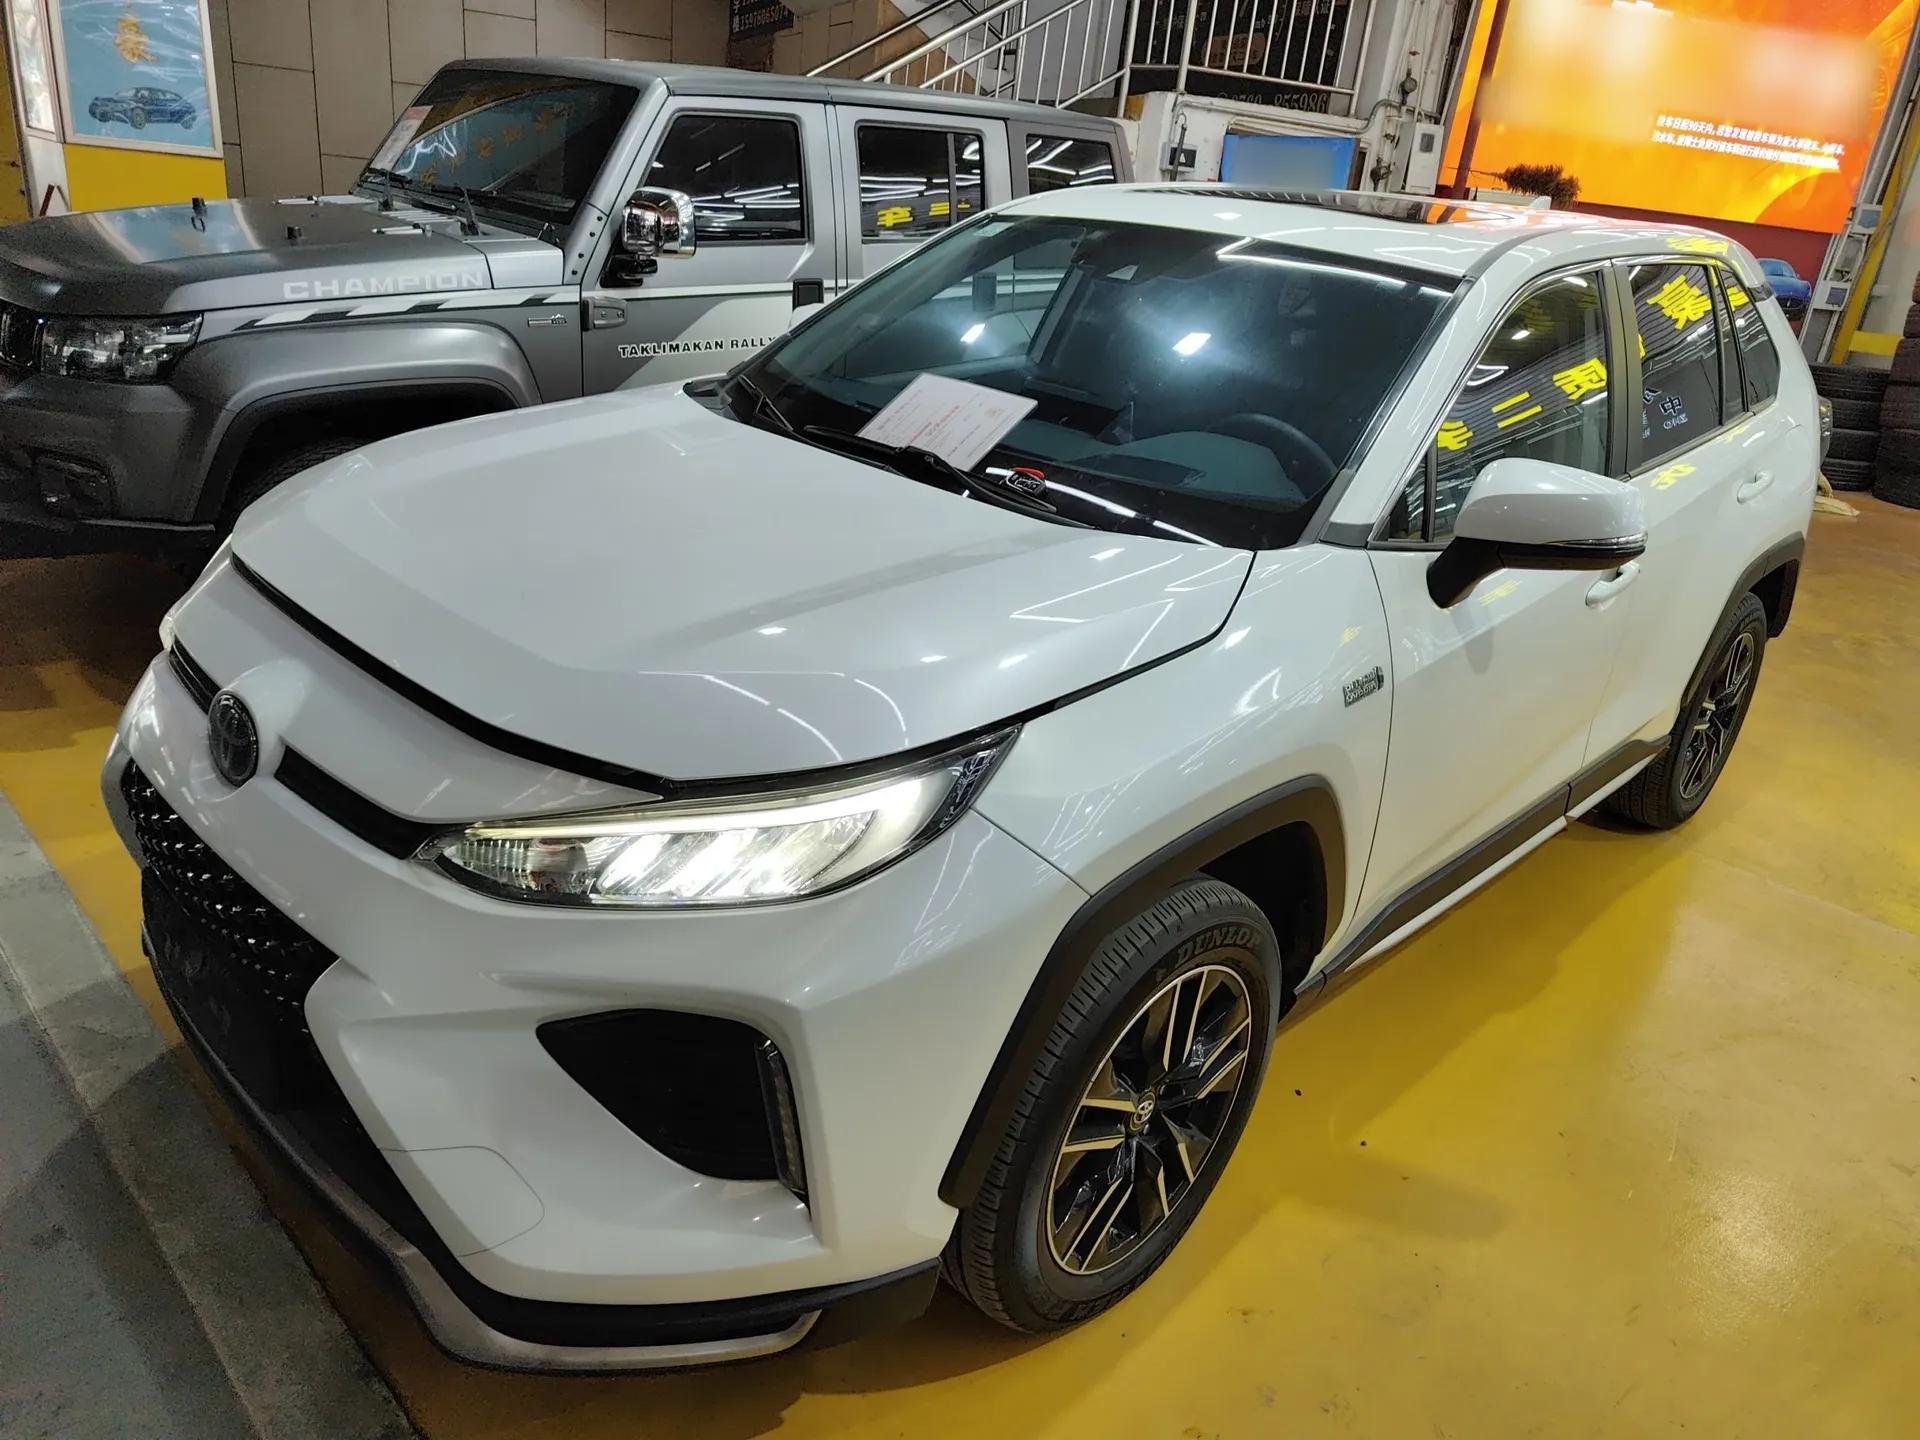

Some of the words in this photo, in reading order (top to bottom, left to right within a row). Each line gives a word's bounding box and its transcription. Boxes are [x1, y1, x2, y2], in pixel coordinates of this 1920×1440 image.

[283, 271, 484, 299] CHAMPION
[618, 338, 724, 358] TAKLIMAKAN
[1176, 925, 1262, 964] DUNLOP
